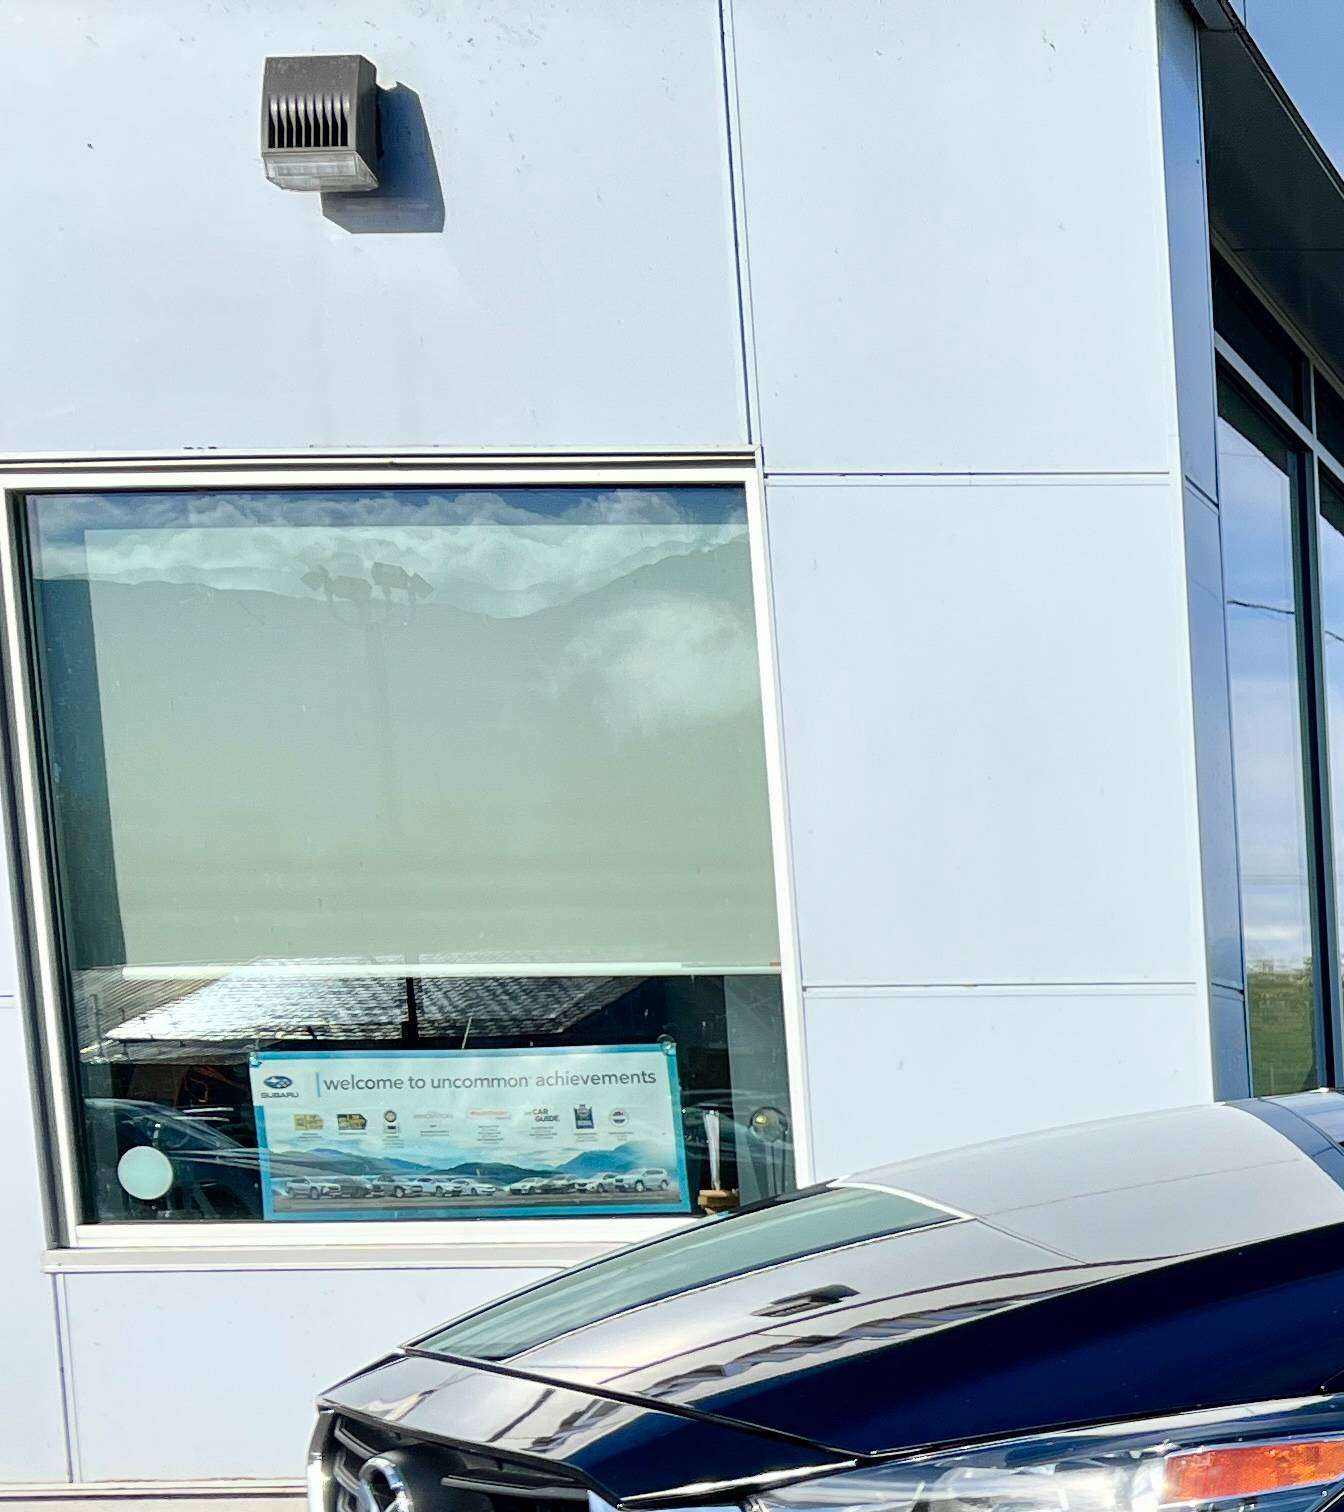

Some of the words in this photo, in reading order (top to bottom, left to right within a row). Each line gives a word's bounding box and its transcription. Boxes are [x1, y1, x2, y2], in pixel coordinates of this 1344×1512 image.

[324, 1074, 403, 1090] welcome
[409, 1076, 425, 1089] to
[430, 1075, 529, 1089] uncommon
[535, 1070, 656, 1087] achievements
